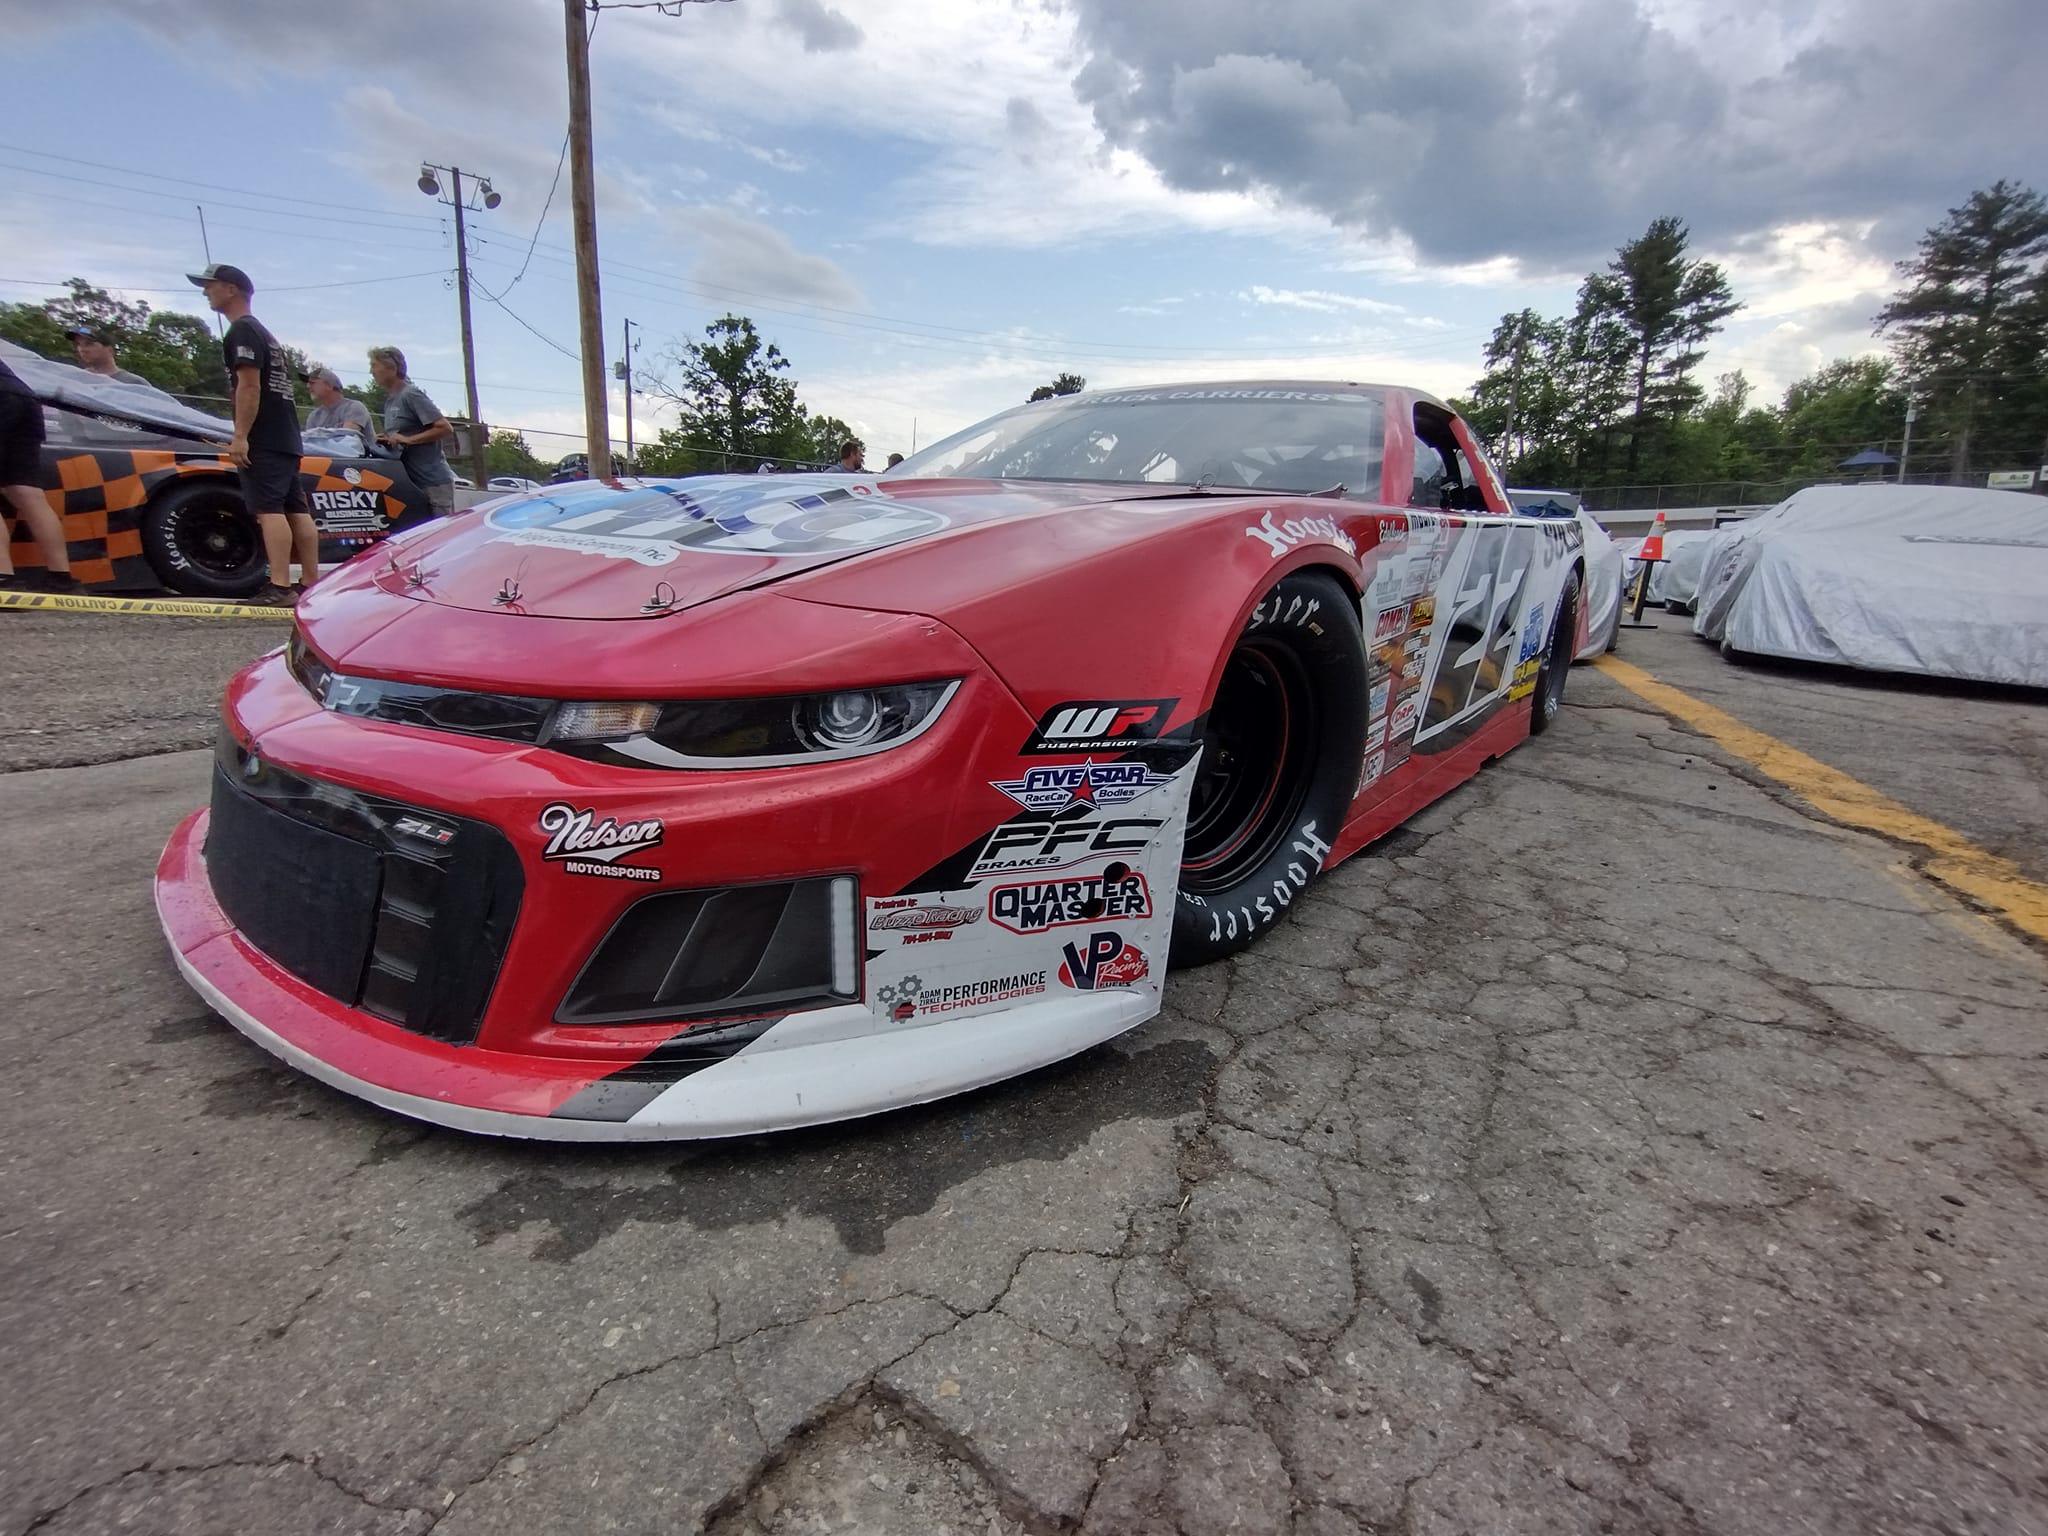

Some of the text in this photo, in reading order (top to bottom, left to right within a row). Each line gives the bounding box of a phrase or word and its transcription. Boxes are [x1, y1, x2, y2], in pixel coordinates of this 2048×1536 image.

[1169, 390, 1330, 401] CARRIERS
[312, 491, 378, 510] RISKY
[325, 510, 375, 518] BUSINESS
[160, 511, 192, 571] Hoosier
[55, 597, 117, 610] CAUTION
[155, 603, 211, 615] CUIDADO
[1249, 583, 1321, 630] sier
[1036, 740, 1138, 750] SUSPENSION
[1026, 766, 1146, 792] FIVE STAR
[1099, 788, 1136, 798] Bodies
[397, 817, 454, 842] ZL1
[541, 804, 662, 855] Nelson
[981, 818, 1165, 861] PFC
[566, 861, 661, 880] MOTORSPORTS
[974, 856, 1062, 871] BRAKES
[1209, 819, 1332, 942] Hoosier
[995, 876, 1141, 917] QUARTER
[1021, 895, 1146, 929] MASER
[1062, 931, 1124, 990] VP
[1100, 959, 1145, 982] Racing
[919, 970, 1047, 1002] ADAM PERFORMANCE
[919, 985, 1046, 1015] TECHNOLOGIES
[919, 996, 941, 1006] ZIRKLE
